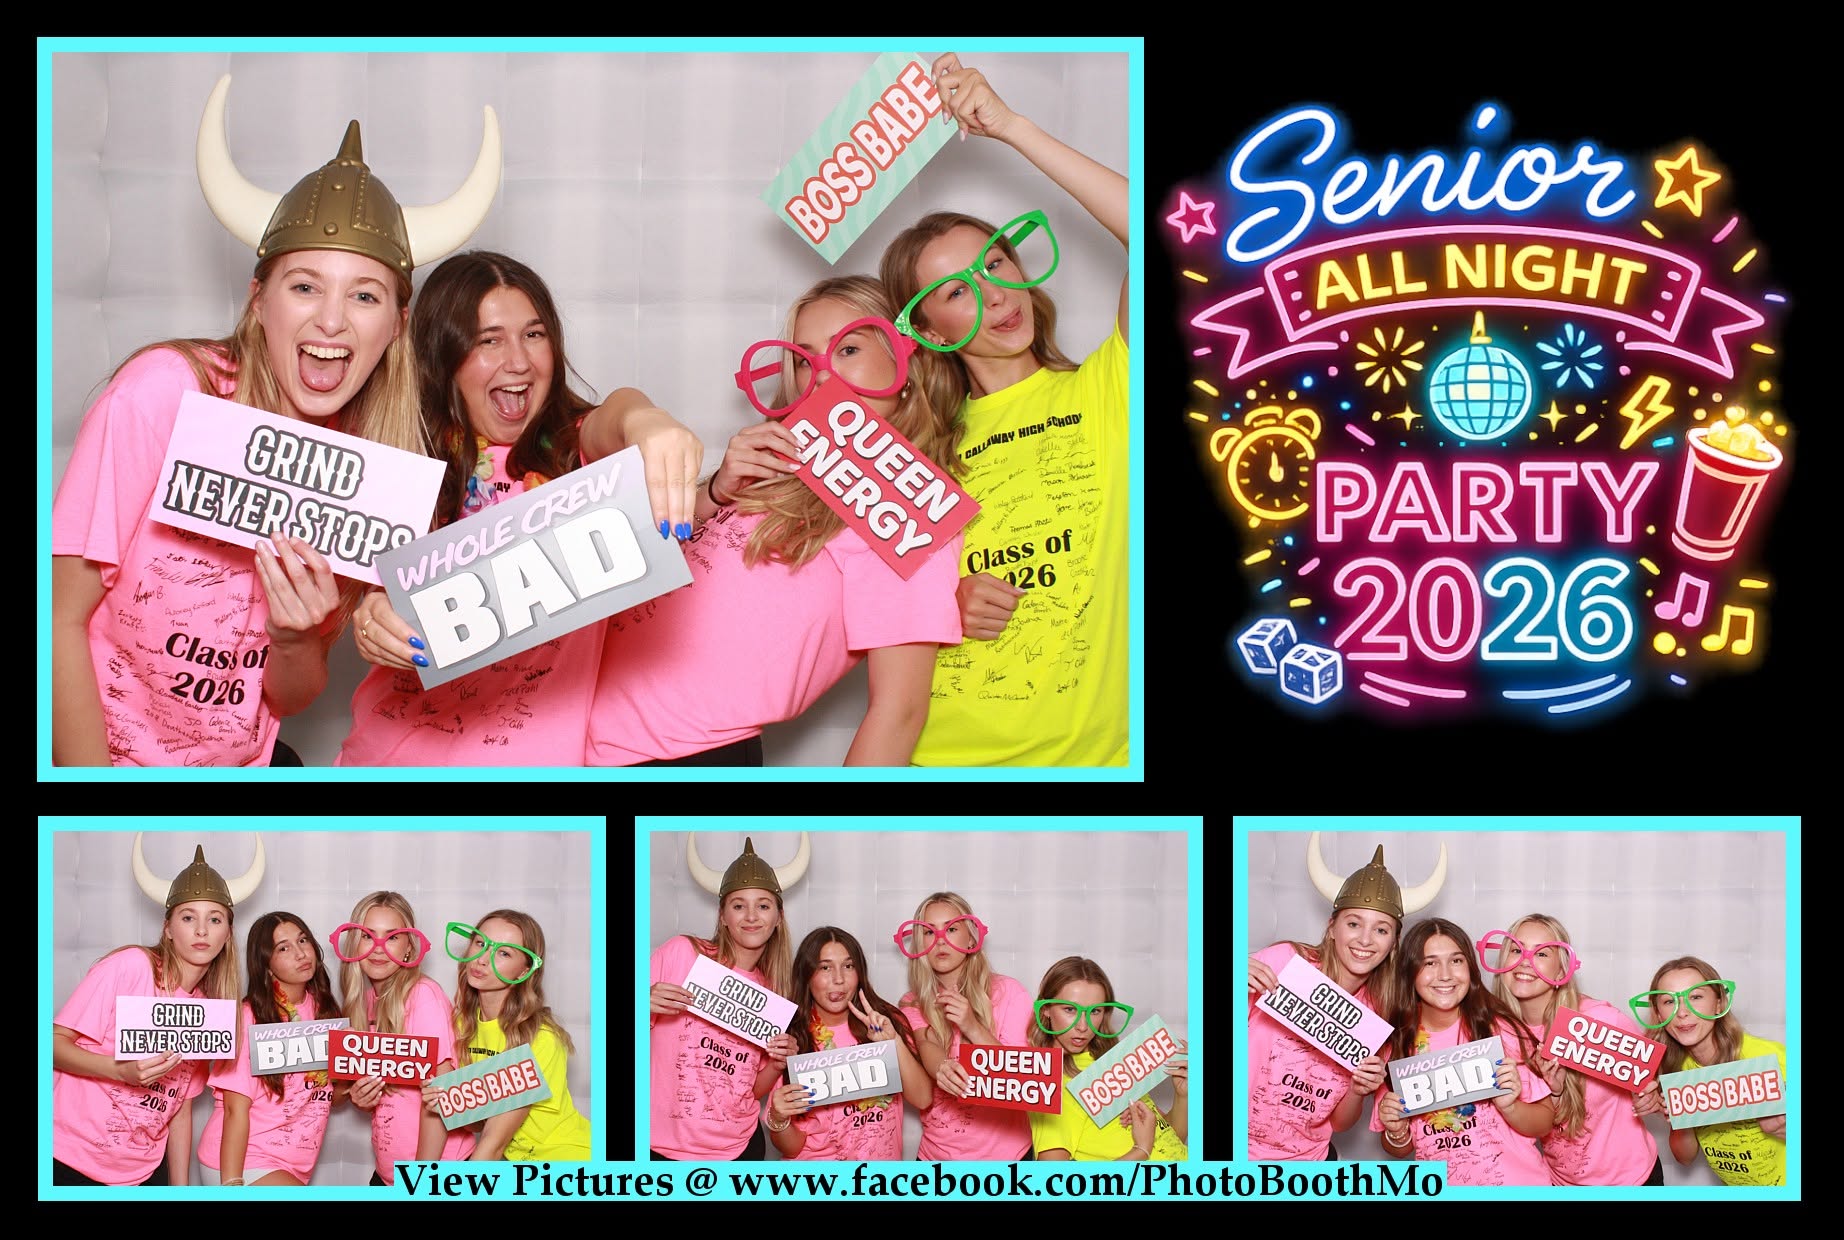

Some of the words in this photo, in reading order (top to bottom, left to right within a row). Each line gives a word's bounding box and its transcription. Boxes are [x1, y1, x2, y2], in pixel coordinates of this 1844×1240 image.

[784, 142, 876, 244] BOSS
[849, 60, 943, 172] BABE
[1225, 105, 1635, 263] Senior
[1316, 250, 1428, 310] ALL
[1445, 243, 1648, 305] NIGHT
[965, 431, 1015, 459] CALLAWAY
[1018, 422, 1045, 439] HIGH
[244, 425, 365, 501] GRIND
[827, 400, 961, 524] QUEEN
[163, 460, 292, 534] NEVER
[1316, 461, 1660, 544] PARTY
[397, 515, 515, 592] WHOLE
[521, 462, 622, 536] CREW
[967, 541, 1035, 575] Class
[1045, 529, 1073, 554] of
[409, 506, 648, 670] BAD
[1003, 564, 1056, 589] 026
[1332, 556, 1634, 662] 2026
[165, 632, 238, 671] Class
[243, 645, 270, 669] of
[170, 672, 245, 706] 2026
[719, 975, 768, 1013] GRIND
[1310, 982, 1363, 1030] GRIND
[152, 1003, 205, 1027] GRIND
[255, 1025, 302, 1041] WHOLE
[303, 1021, 342, 1036] CREW
[1264, 984, 1324, 1037] NEVER
[1318, 1021, 1370, 1067] STOPS
[120, 1029, 181, 1053] NEVER
[181, 1031, 232, 1053] STOPS
[342, 1034, 429, 1058] QUEEN
[700, 1036, 732, 1058] Class
[735, 1052, 750, 1063] of
[794, 1053, 843, 1072] WHOLE
[846, 1044, 888, 1061] CREW
[1568, 1016, 1655, 1064] QUEEN
[334, 1056, 432, 1080] ENERGY
[704, 1054, 736, 1076] 2026
[971, 1048, 1052, 1075] QUEEN
[1079, 1062, 1134, 1116] BOSS
[1124, 1028, 1178, 1082] BABE
[1396, 1055, 1447, 1078] WHOLE
[1448, 1041, 1493, 1065] CREW
[1549, 1035, 1650, 1087] ENERGY
[437, 1077, 488, 1118] BOSS
[484, 1059, 541, 1106] BABE
[797, 1058, 889, 1104] BAD
[966, 1074, 1057, 1106] ENERGY
[1281, 1073, 1314, 1095] Class
[1316, 1088, 1332, 1100] of
[1400, 1057, 1496, 1112] BAD
[1668, 1080, 1722, 1116] BOSS
[1721, 1069, 1781, 1108] BABE
[853, 1110, 884, 1127] 2026
[1281, 1091, 1316, 1113] 2026
[1435, 1134, 1472, 1150] 2026
[1463, 1116, 1477, 1130] of
[1704, 1146, 1736, 1160] Class
[1739, 1150, 1752, 1160] of
[1717, 1161, 1749, 1173] 2026
